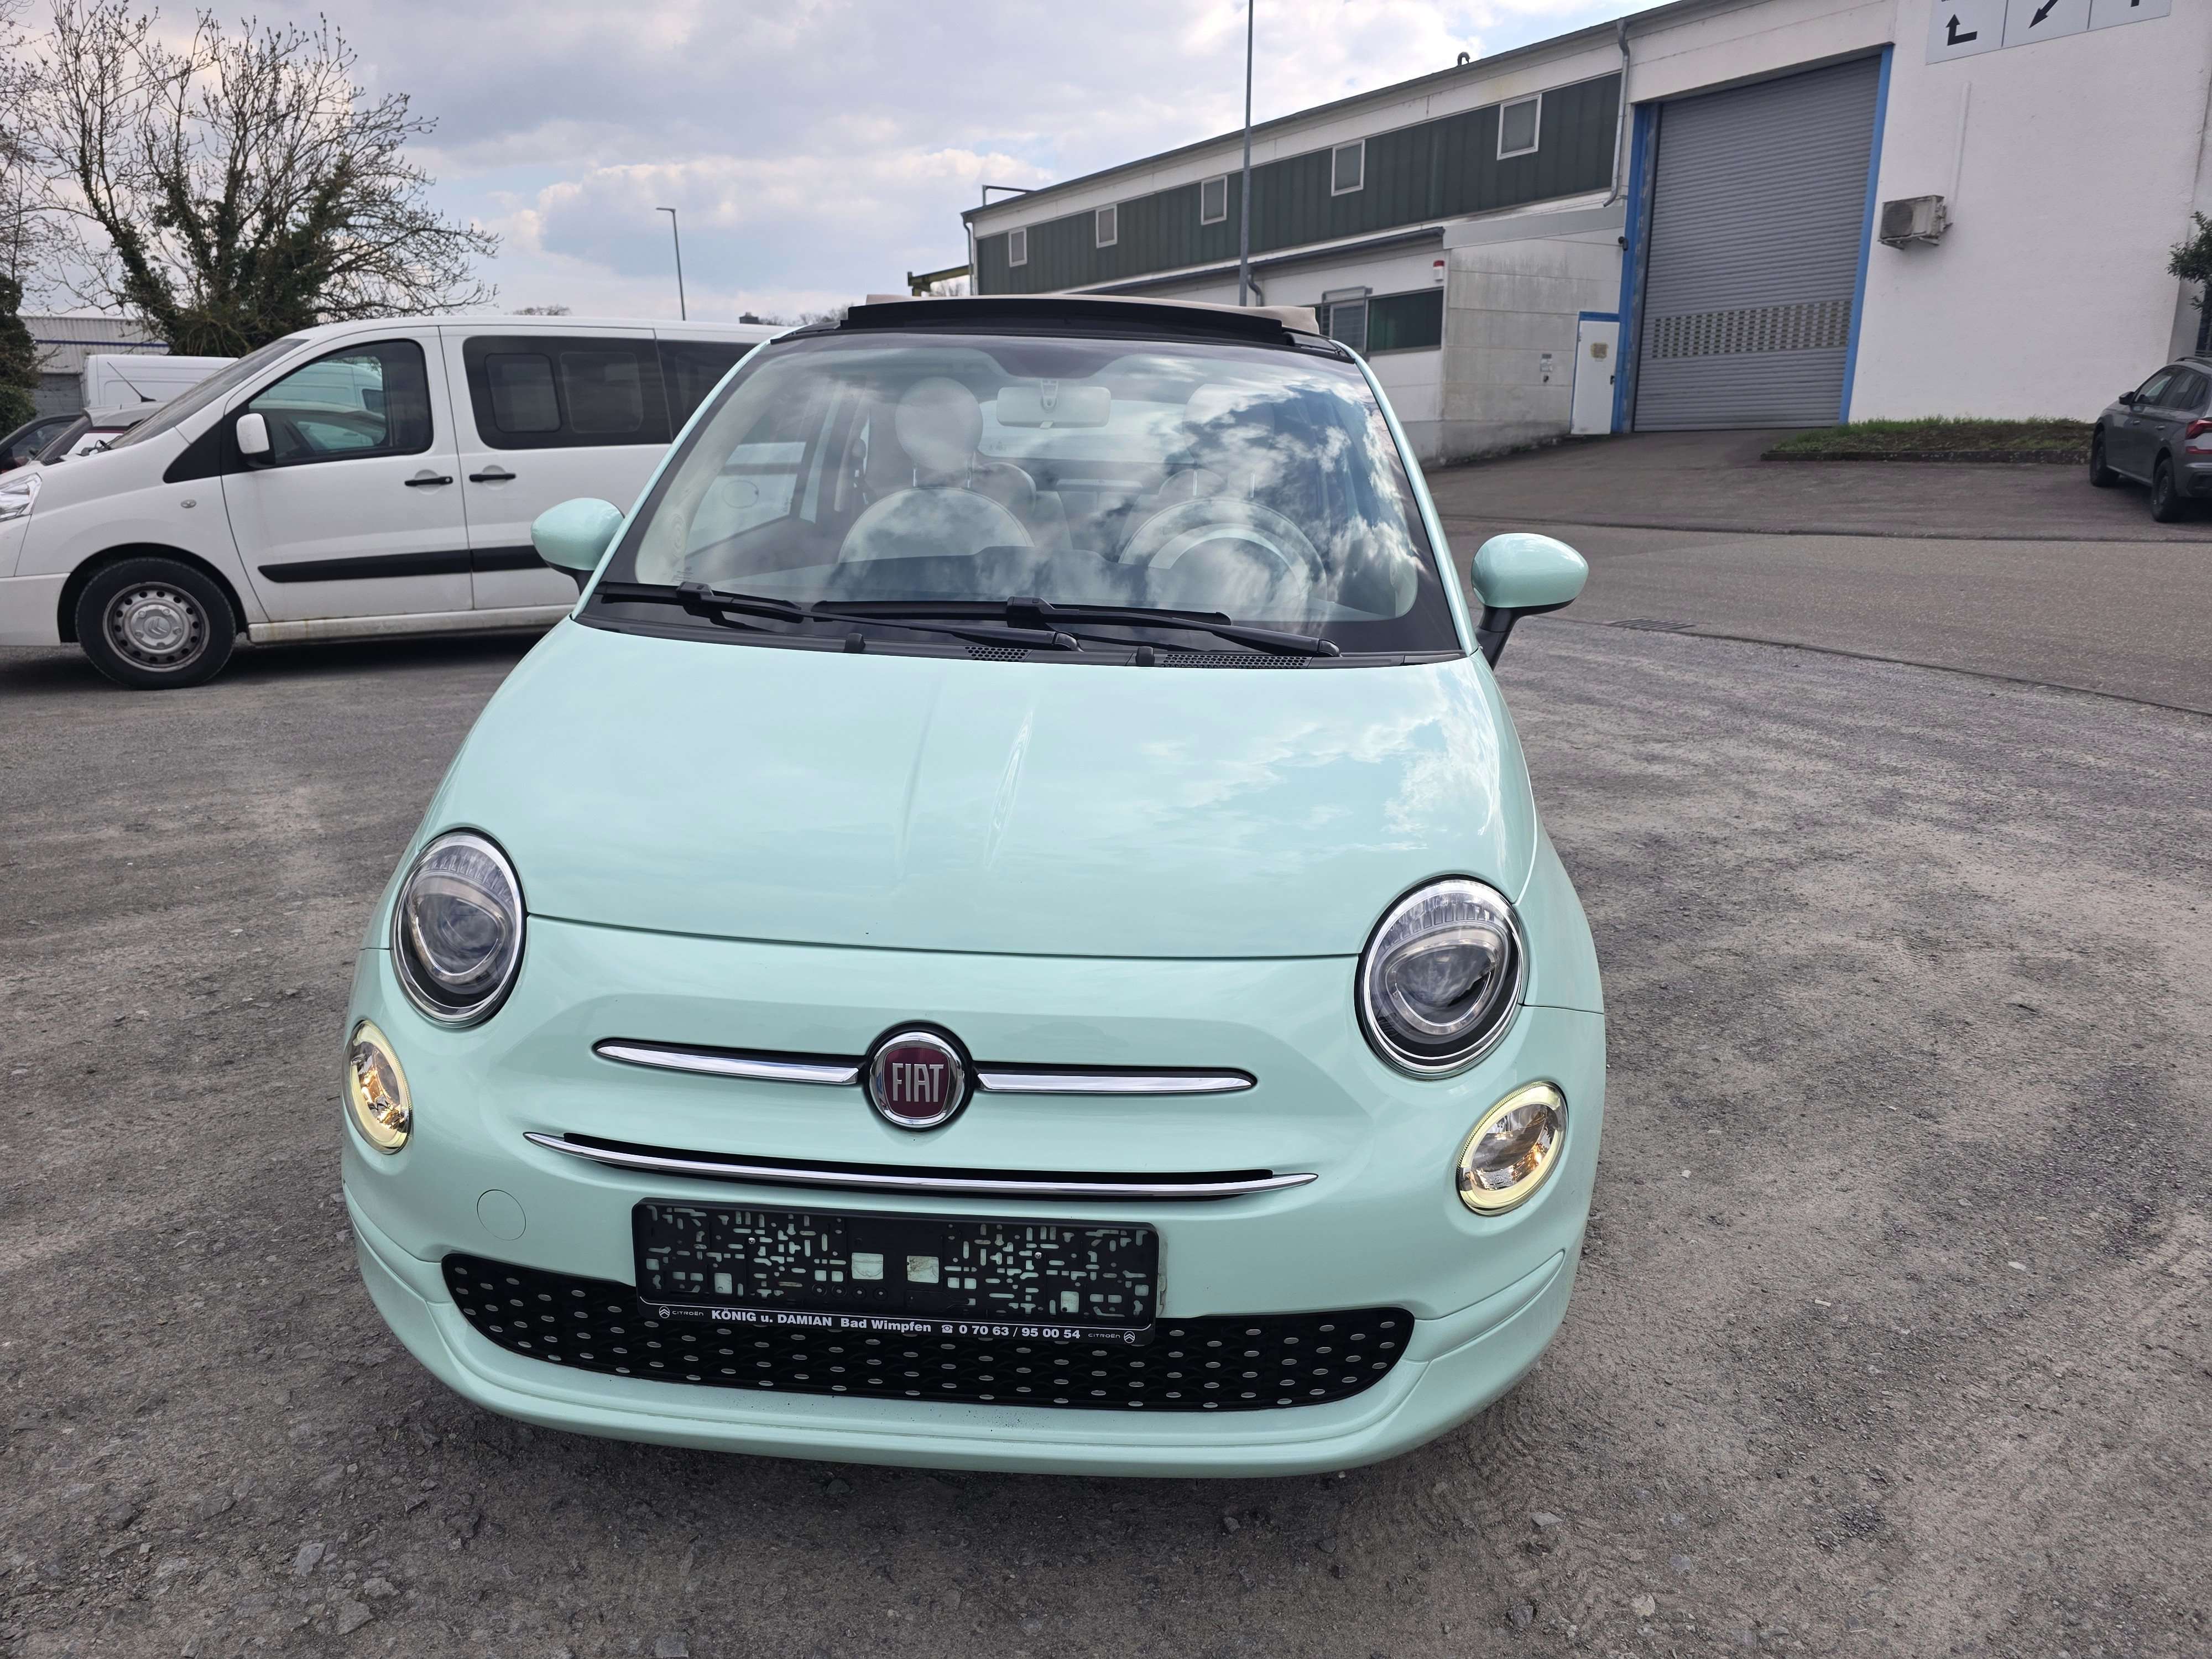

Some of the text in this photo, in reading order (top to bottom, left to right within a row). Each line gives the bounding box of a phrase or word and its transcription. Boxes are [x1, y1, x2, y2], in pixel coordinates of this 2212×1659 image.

[892, 1062, 945, 1103] FIAT
[712, 1309, 757, 1322] KÖNIG
[777, 1314, 832, 1327] DAMIAN
[841, 1318, 867, 1328] Bad
[871, 1319, 932, 1333] Wimpfen
[959, 1324, 968, 1334] 0
[972, 1325, 989, 1335] 70
[992, 1326, 1009, 1336] 63
[1013, 1327, 1018, 1337] /
[1021, 1327, 1039, 1337] 95
[1042, 1328, 1060, 1338] 00
[1063, 1329, 1081, 1339] 54
